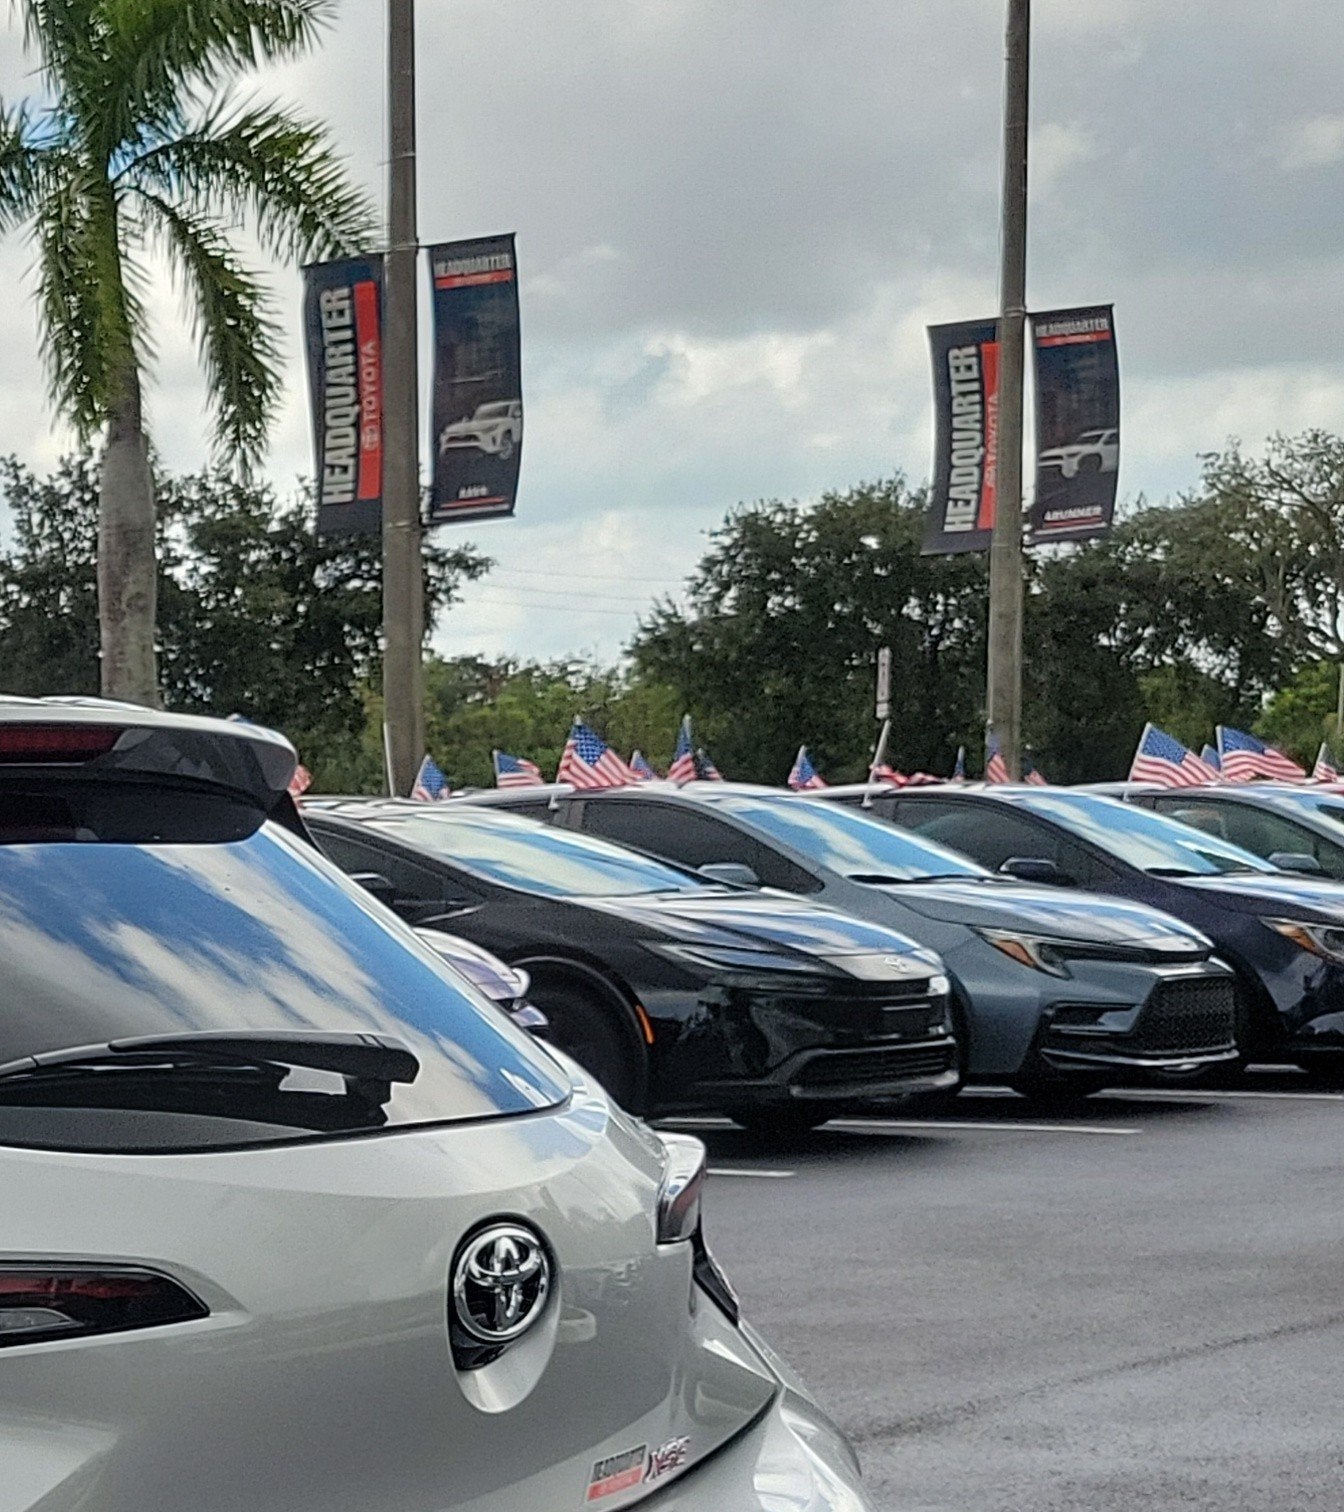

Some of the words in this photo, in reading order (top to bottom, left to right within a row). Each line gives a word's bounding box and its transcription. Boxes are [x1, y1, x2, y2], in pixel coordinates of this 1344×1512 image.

[320, 286, 358, 505] HEADQUARTER
[361, 340, 379, 422] TOYOTA
[943, 345, 984, 533] HEADQUARTER
